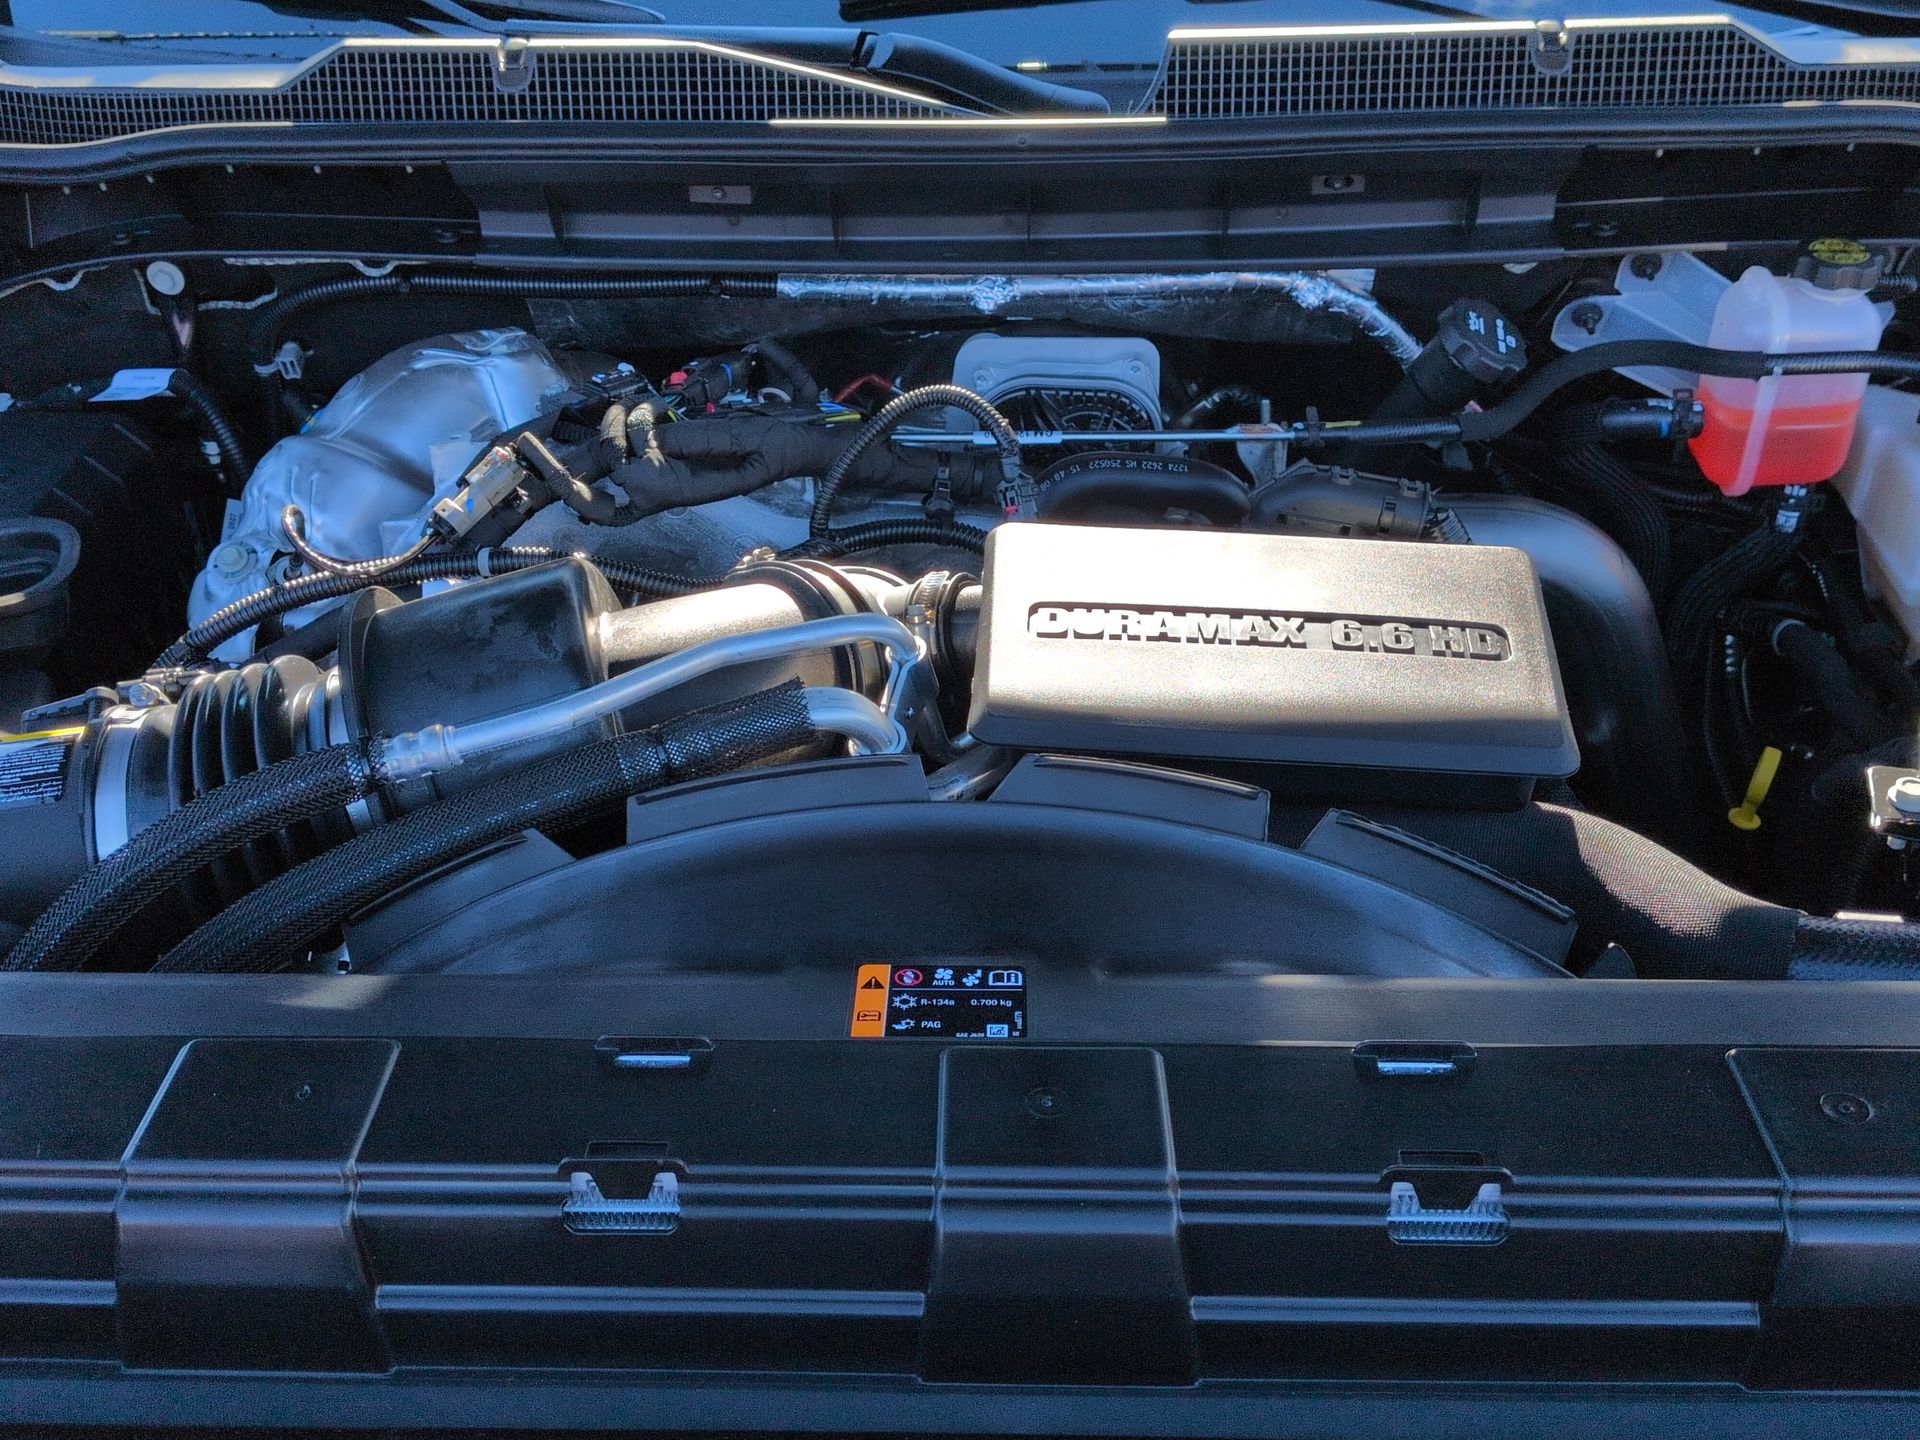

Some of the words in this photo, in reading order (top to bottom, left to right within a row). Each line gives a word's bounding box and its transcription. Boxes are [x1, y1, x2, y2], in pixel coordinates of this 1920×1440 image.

[1032, 606, 1305, 647] DURAMAX
[1331, 619, 1413, 651] 6.6
[1428, 625, 1502, 656] HD
[1000, 999, 1012, 1007] kg
[921, 1020, 941, 1029] PAG
